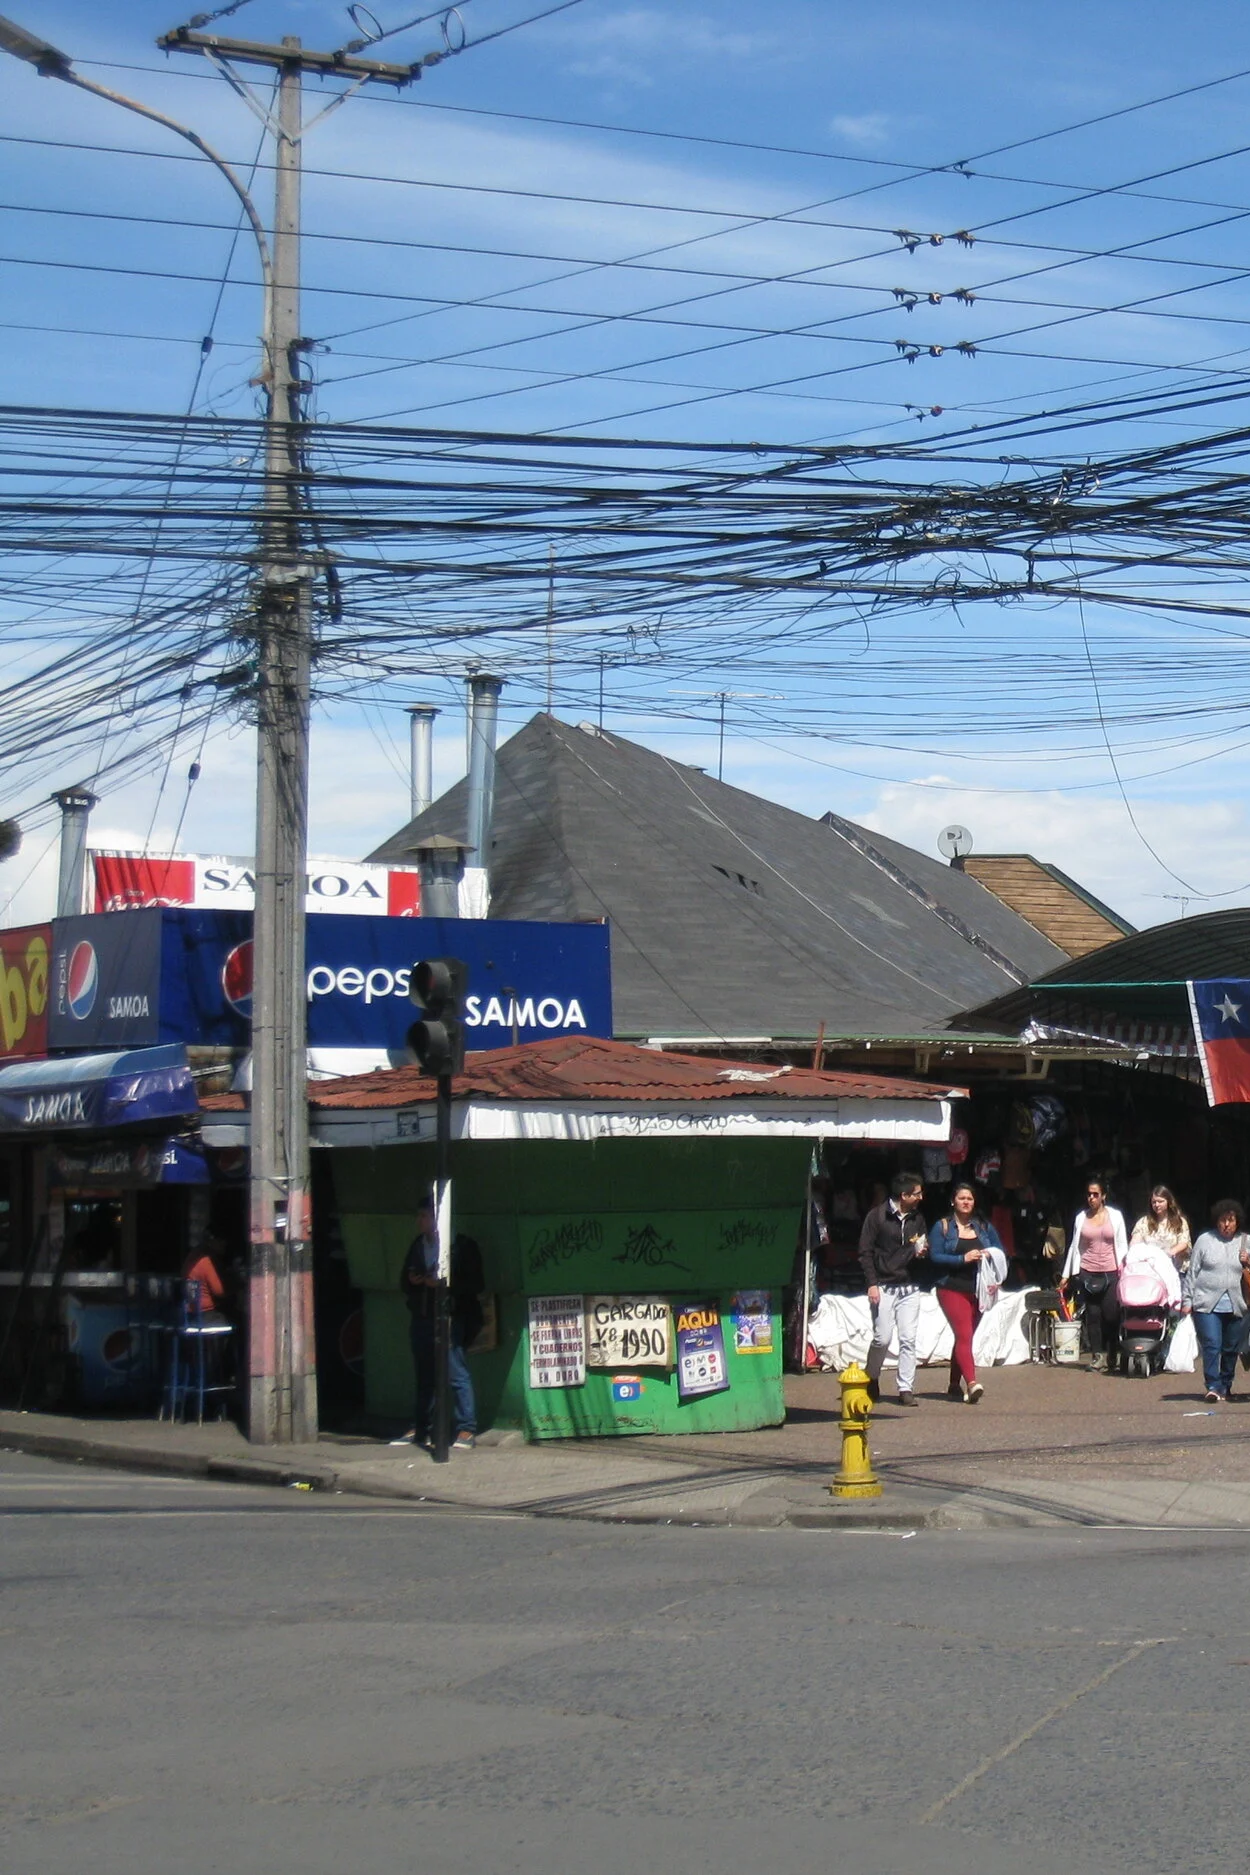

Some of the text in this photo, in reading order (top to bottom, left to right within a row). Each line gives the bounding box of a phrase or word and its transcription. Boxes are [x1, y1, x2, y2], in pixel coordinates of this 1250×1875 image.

[203, 867, 385, 900] SAOA
[307, 961, 420, 1005] peps
[109, 995, 149, 1019] SAMOA
[464, 995, 588, 1029] SAMOA
[25, 1091, 86, 1123] SAMOA
